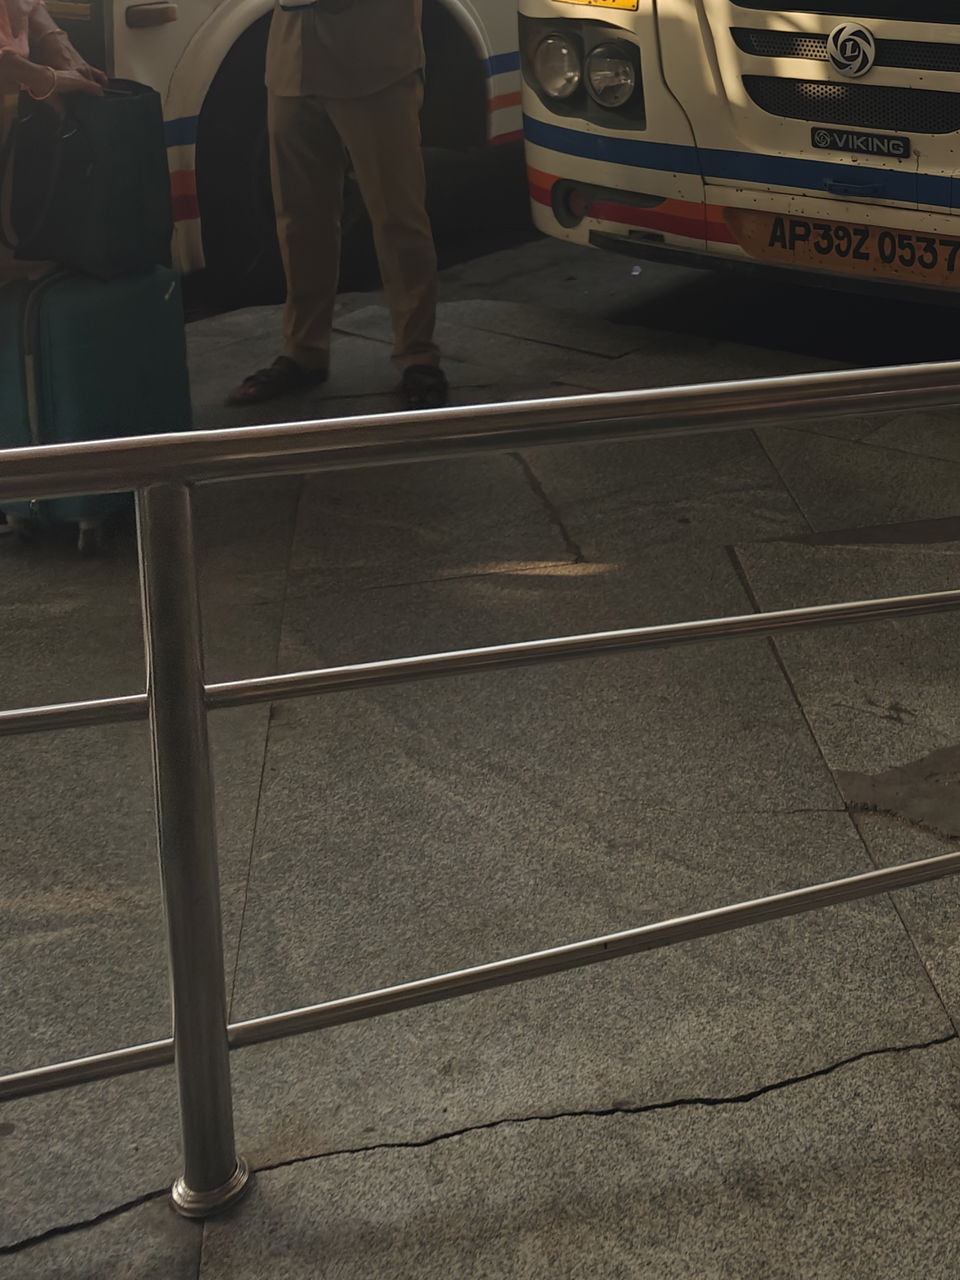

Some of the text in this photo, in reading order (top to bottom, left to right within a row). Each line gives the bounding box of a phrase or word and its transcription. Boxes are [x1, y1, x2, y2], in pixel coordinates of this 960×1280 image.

[833, 132, 904, 155] VIKING
[768, 216, 960, 273] AP39Z 0537
